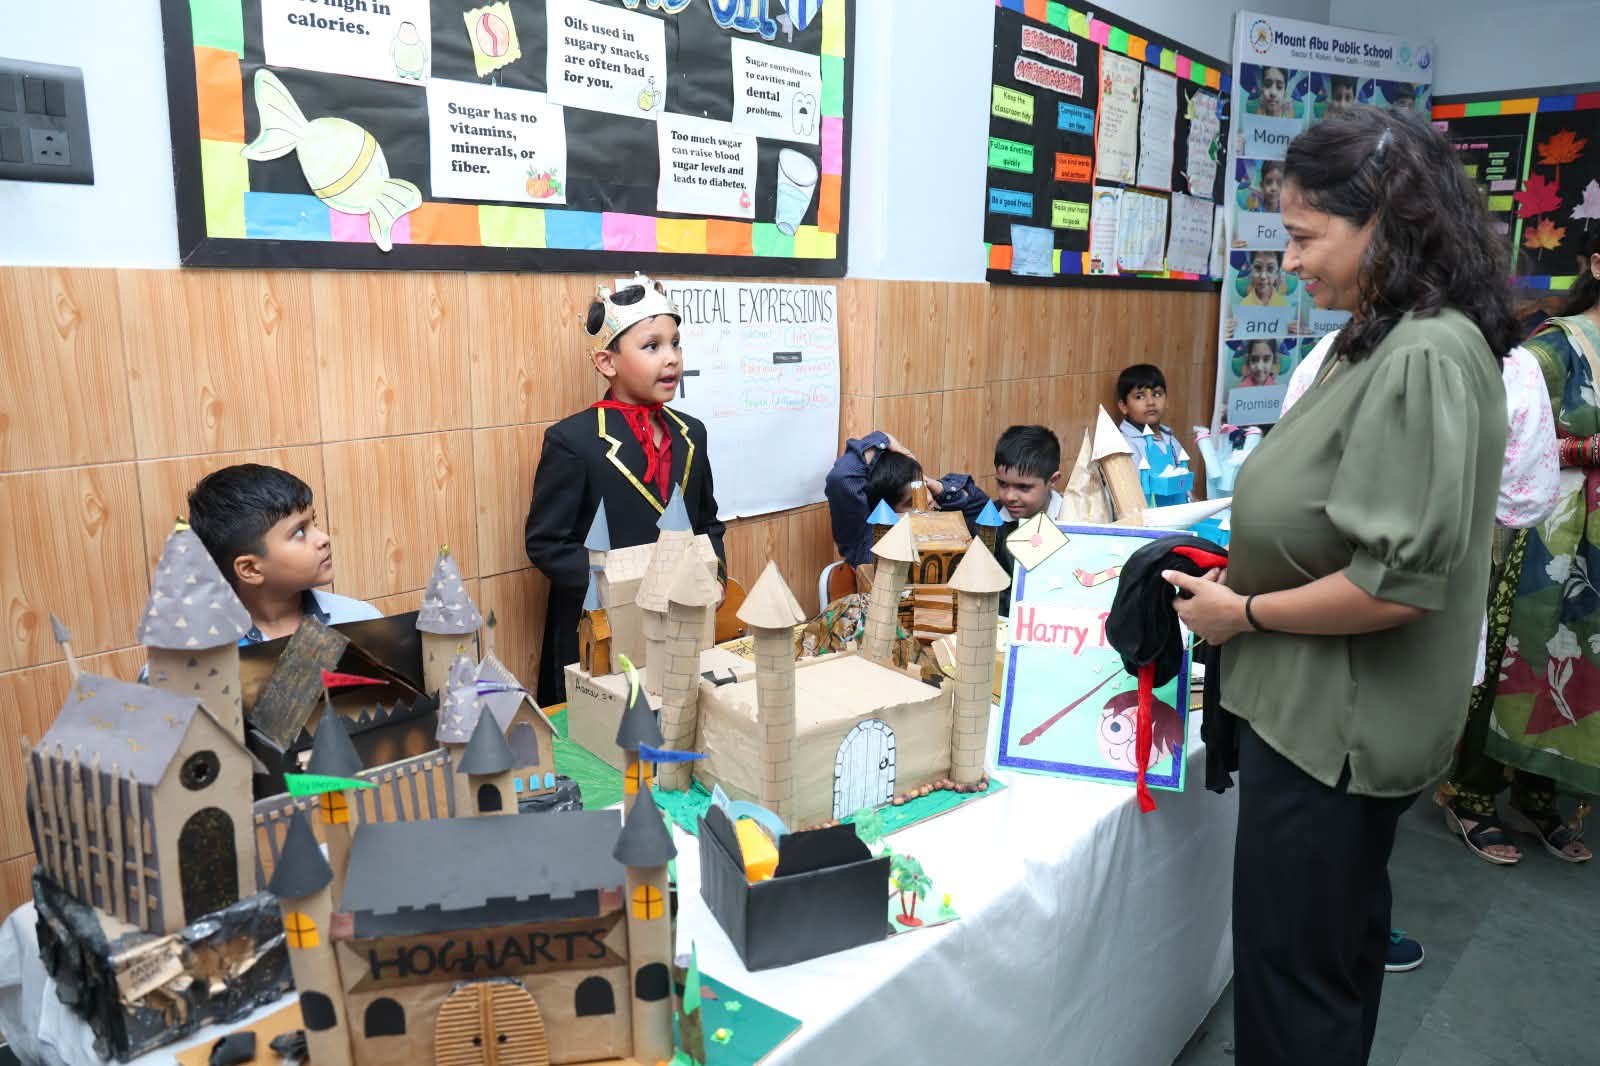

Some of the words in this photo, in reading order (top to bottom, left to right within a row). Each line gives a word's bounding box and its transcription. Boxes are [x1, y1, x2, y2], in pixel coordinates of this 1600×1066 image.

[323, 0, 368, 12] high
[373, 0, 391, 16] in
[287, 12, 370, 36] calories.
[564, 16, 589, 33] Oils
[592, 23, 620, 38] used
[622, 29, 635, 42] in
[564, 35, 607, 54] sugary
[610, 46, 650, 62] snacks
[1274, 31, 1306, 48] Mount
[1309, 36, 1329, 51] Abu
[1332, 39, 1360, 56] Public
[1363, 44, 1392, 59] School
[564, 54, 586, 66] are
[588, 56, 622, 73] often
[624, 64, 646, 78] bad
[745, 55, 768, 70] Sugar
[770, 62, 812, 78] contributes
[564, 70, 584, 84] for
[587, 75, 613, 90] you.
[746, 71, 754, 80] to
[756, 74, 785, 86] cavities
[787, 78, 800, 88] and
[746, 87, 780, 102] dental
[448, 102, 490, 120] Sugar
[494, 108, 518, 122] has
[520, 114, 538, 124] no
[746, 104, 782, 119] problems.
[450, 122, 517, 141] vitamins,
[671, 130, 688, 142] Too
[690, 132, 716, 146] much
[718, 138, 742, 150] sugar
[1254, 128, 1290, 145] Mom
[451, 142, 518, 160] minerals,
[520, 149, 536, 160] or
[672, 146, 688, 156] can
[690, 148, 713, 160] raise
[714, 149, 740, 162] blood
[451, 160, 490, 174] fiber.
[672, 160, 699, 173] sugar
[701, 162, 726, 175] levels
[728, 164, 744, 176] and
[673, 173, 696, 186] leads
[698, 176, 708, 186] to
[710, 176, 747, 190] diabetes.
[1257, 225, 1278, 239] For
[664, 288, 732, 324] RICAL
[739, 287, 833, 324] EXPRESSIONS
[1246, 320, 1279, 334] and
[1235, 398, 1280, 412] Promise
[1015, 606, 1089, 655] Harry
